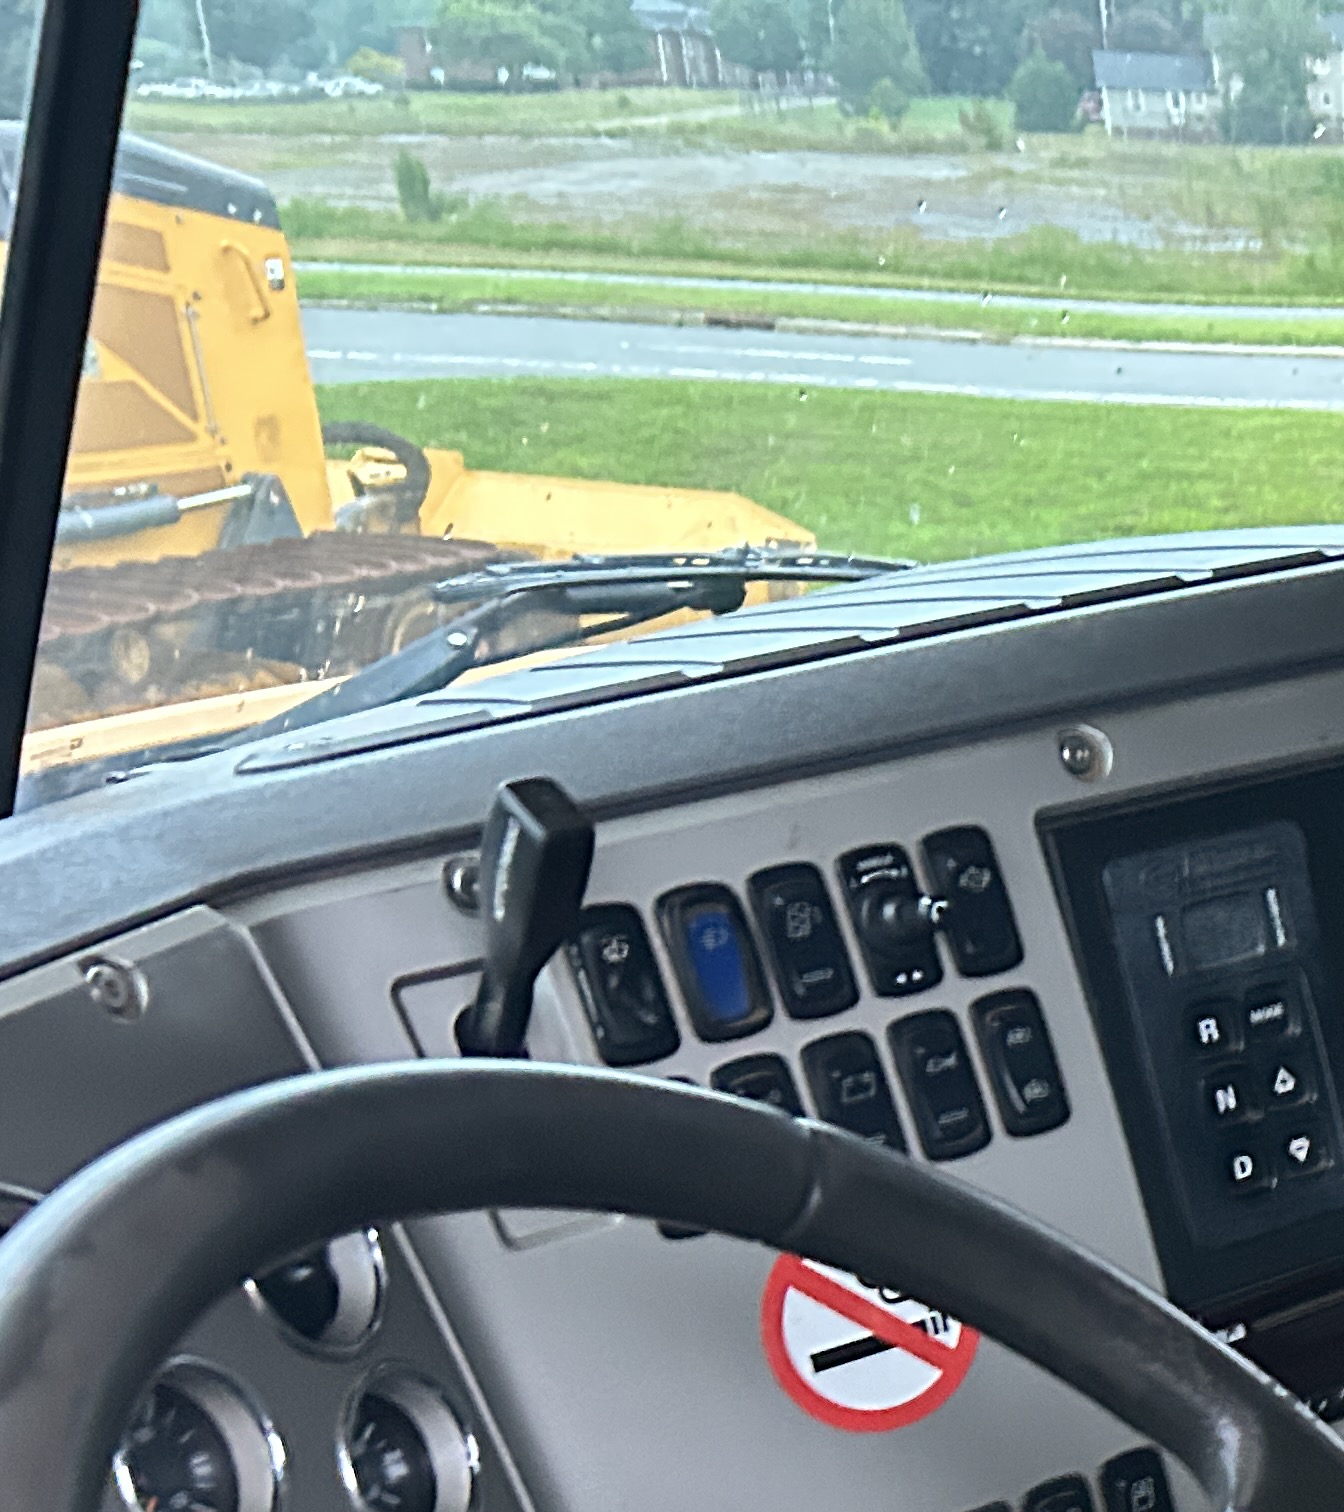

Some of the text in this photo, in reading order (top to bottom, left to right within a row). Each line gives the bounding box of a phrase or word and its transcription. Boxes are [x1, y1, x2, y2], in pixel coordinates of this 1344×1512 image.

[1198, 1018, 1220, 1044] R
[1215, 1084, 1237, 1115] N
[1233, 1155, 1253, 1181] D
